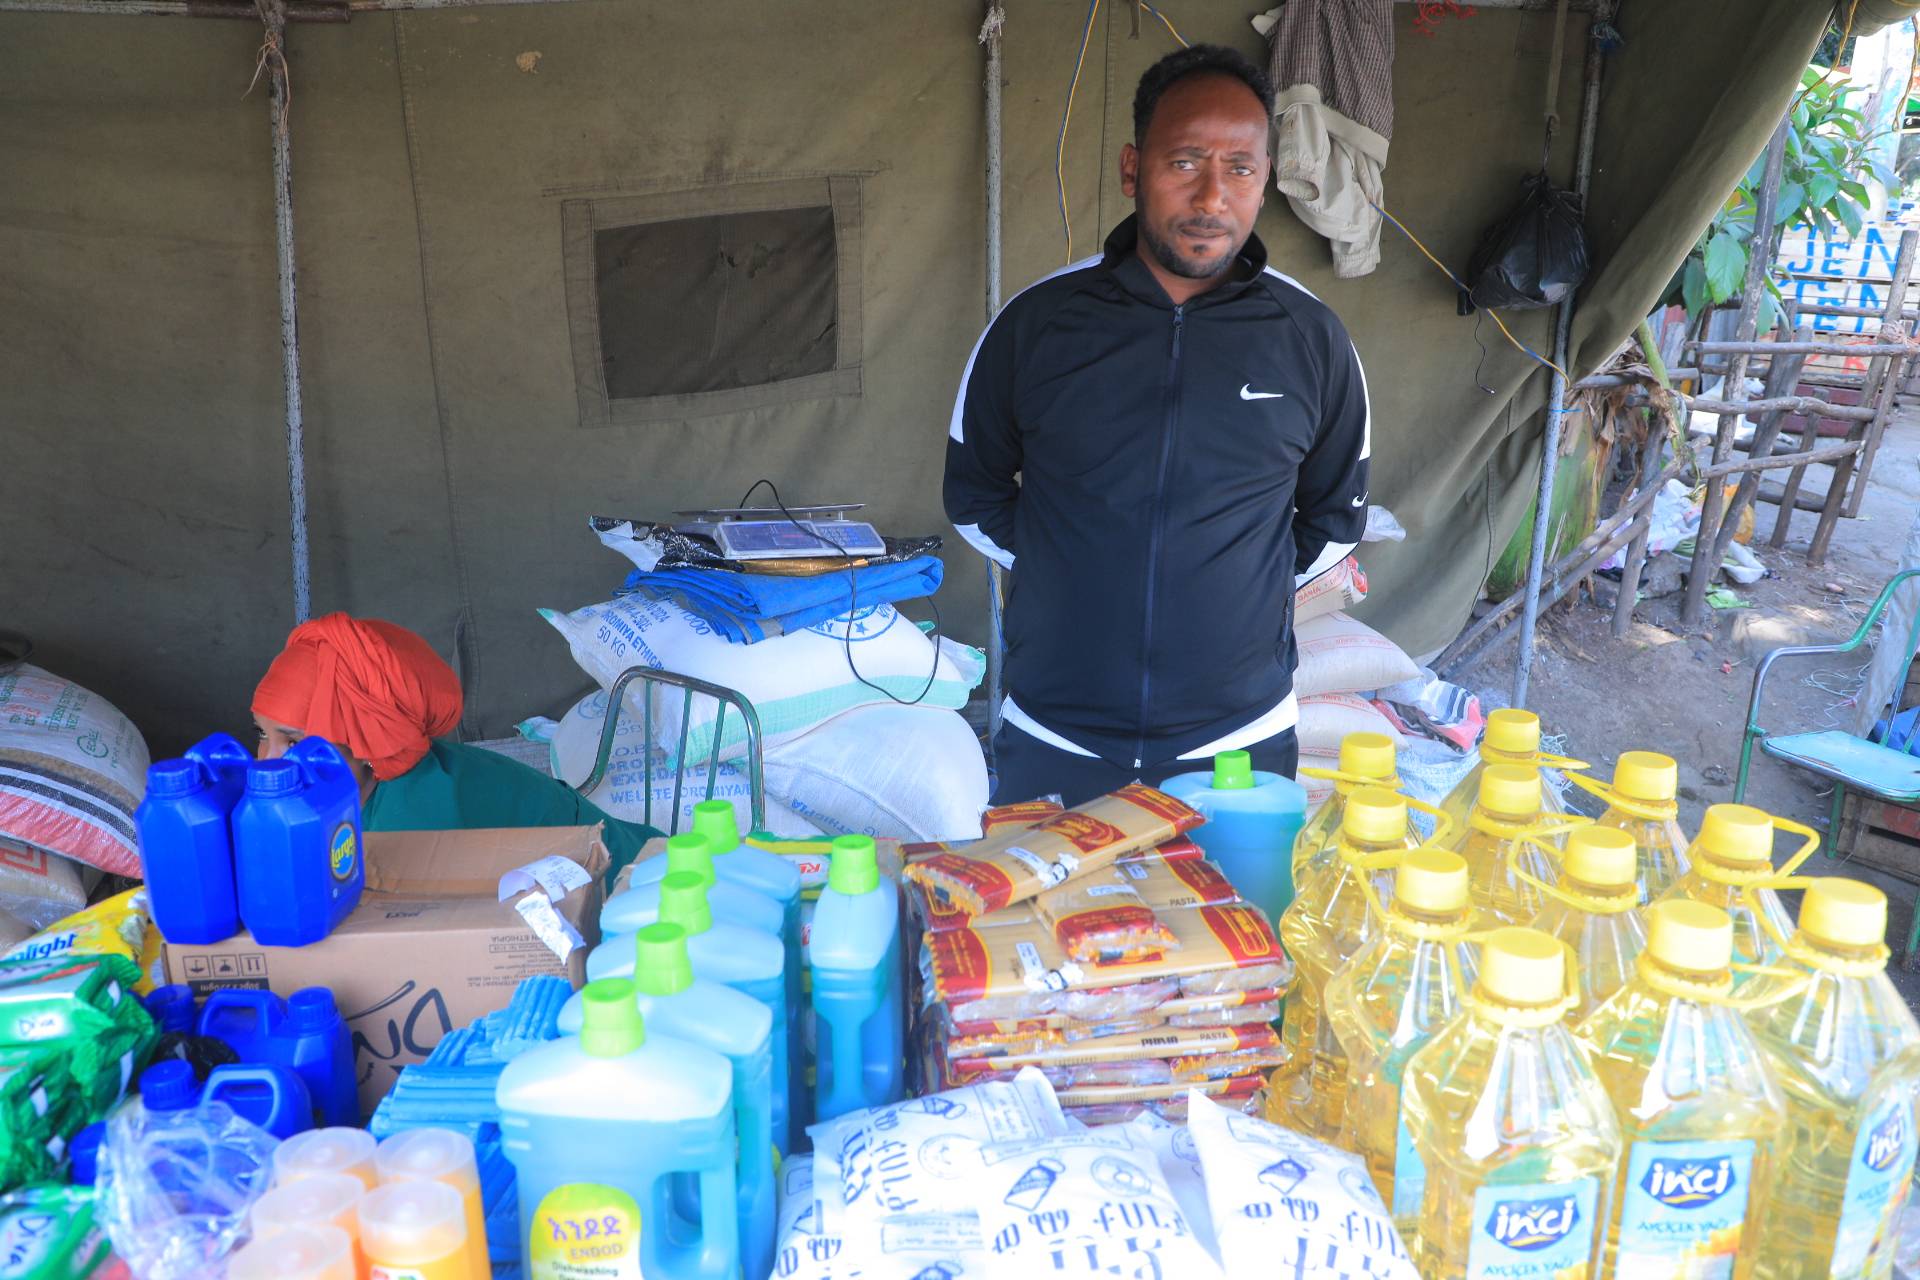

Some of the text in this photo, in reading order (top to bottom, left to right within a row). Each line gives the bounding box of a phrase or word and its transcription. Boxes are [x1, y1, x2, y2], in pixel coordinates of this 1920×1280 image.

[596, 625, 627, 658] 50 KG
[632, 635, 666, 670] ETHIOP
[1199, 1031, 1229, 1041] PASTA
